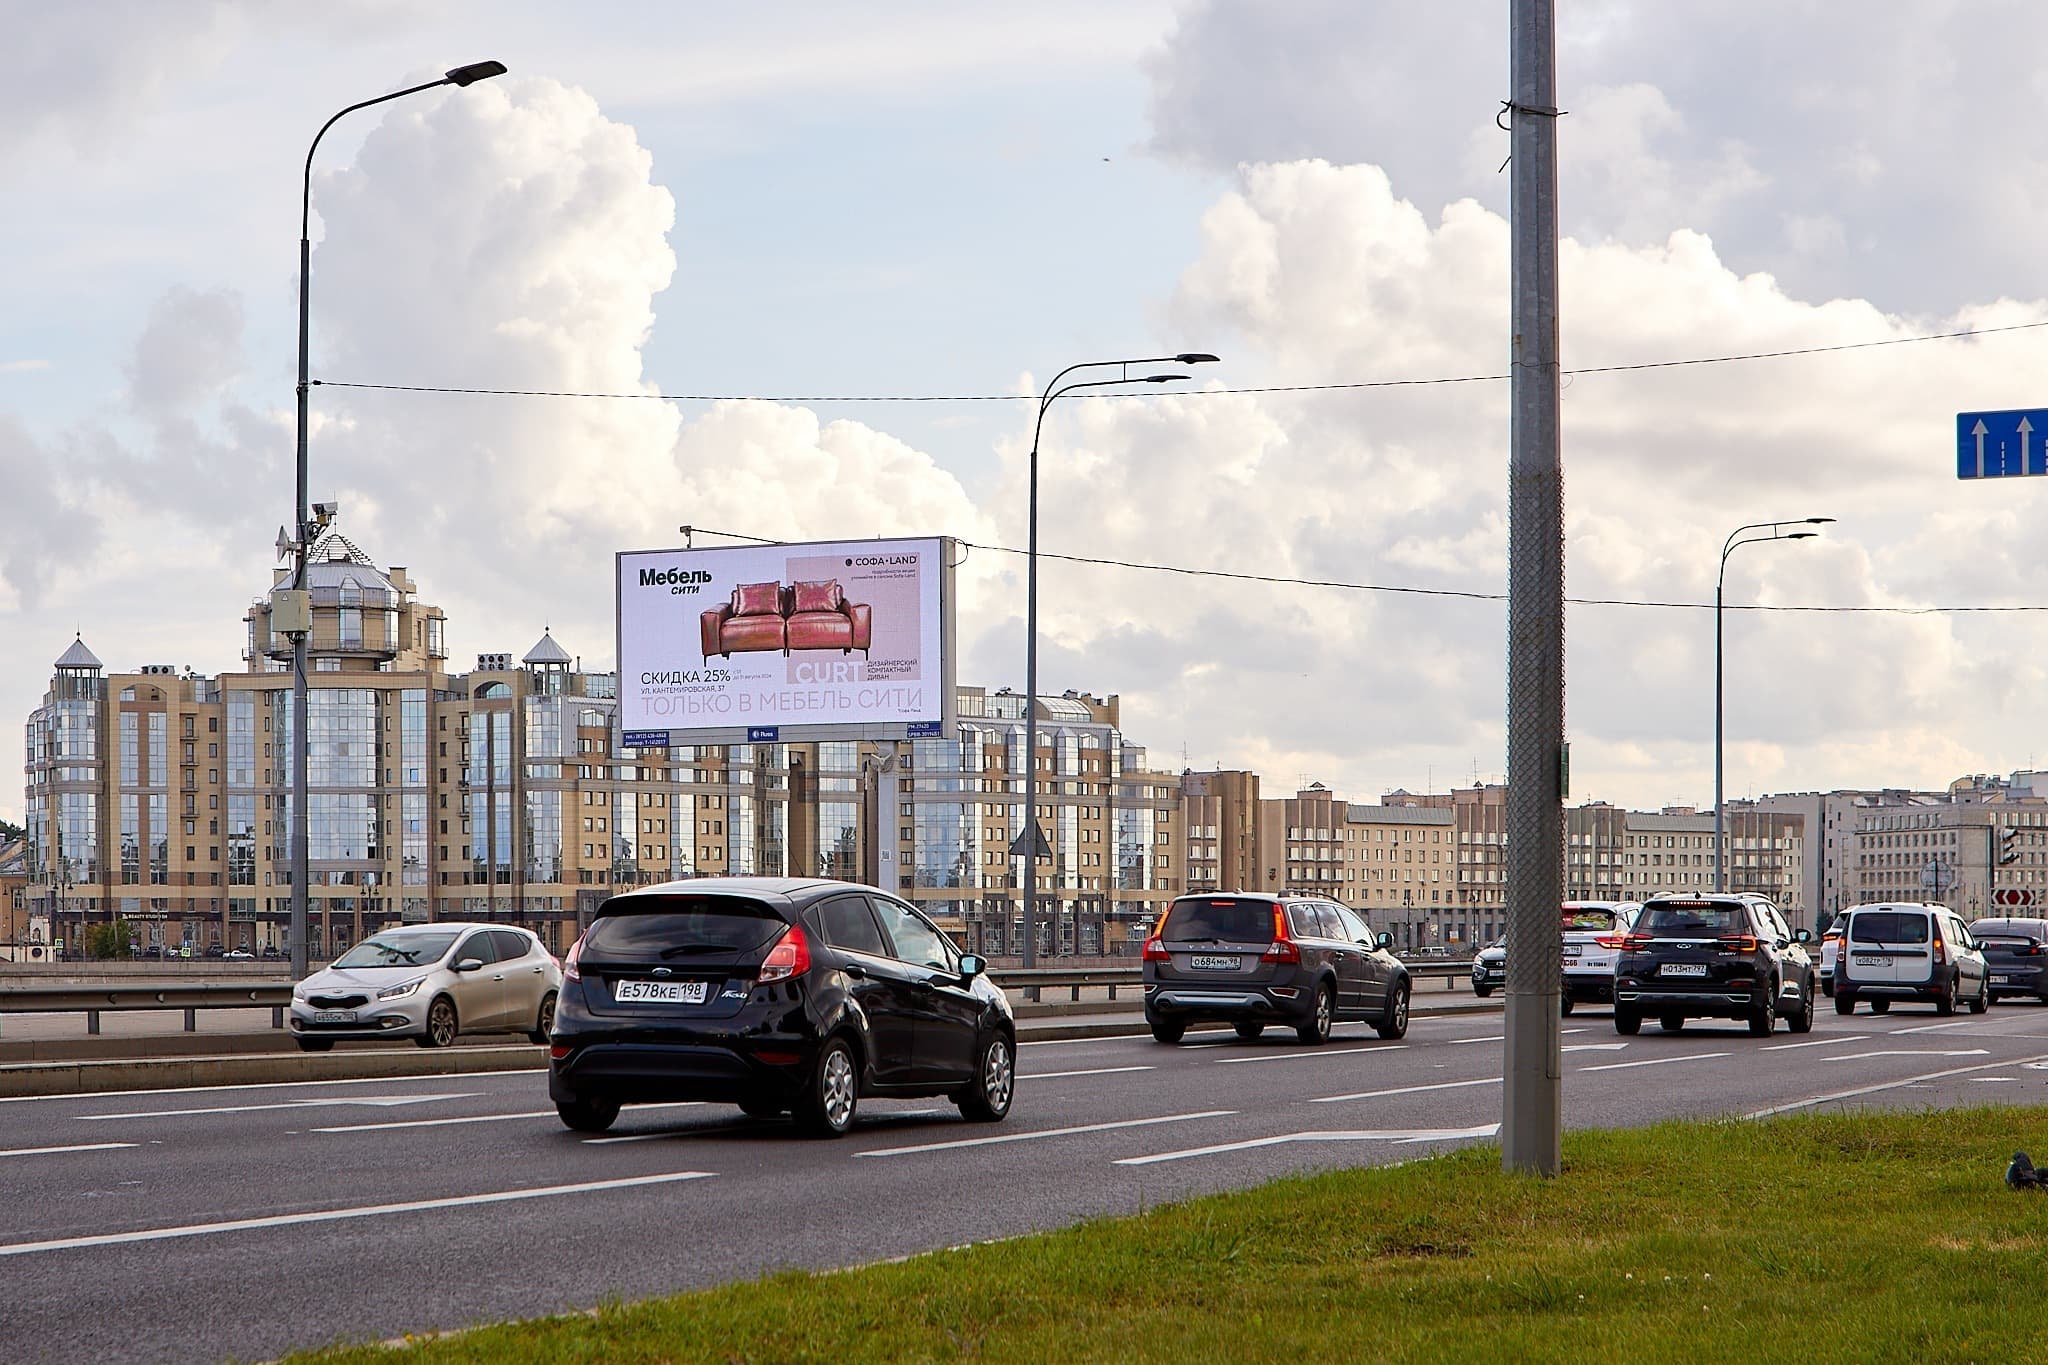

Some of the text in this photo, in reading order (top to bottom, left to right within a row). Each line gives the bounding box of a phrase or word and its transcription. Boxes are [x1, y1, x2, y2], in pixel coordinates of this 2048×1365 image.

[639, 566, 713, 586] Мебель
[867, 659, 918, 668] ДИЗАЙНЕРСКИЙ
[867, 666, 912, 674] КОМПАКТНЫЙ
[641, 669, 731, 686] СКИДКА 25%
[795, 661, 864, 683] CURT
[640, 687, 652, 695] УЛ.
[652, 685, 717, 694] КАНТЕМИРОВСКАЯ,
[641, 687, 922, 716] ТОЛЬКО В МЕБЕЛЬ СИТИ
[622, 984, 702, 999] Е578КЕ 198
